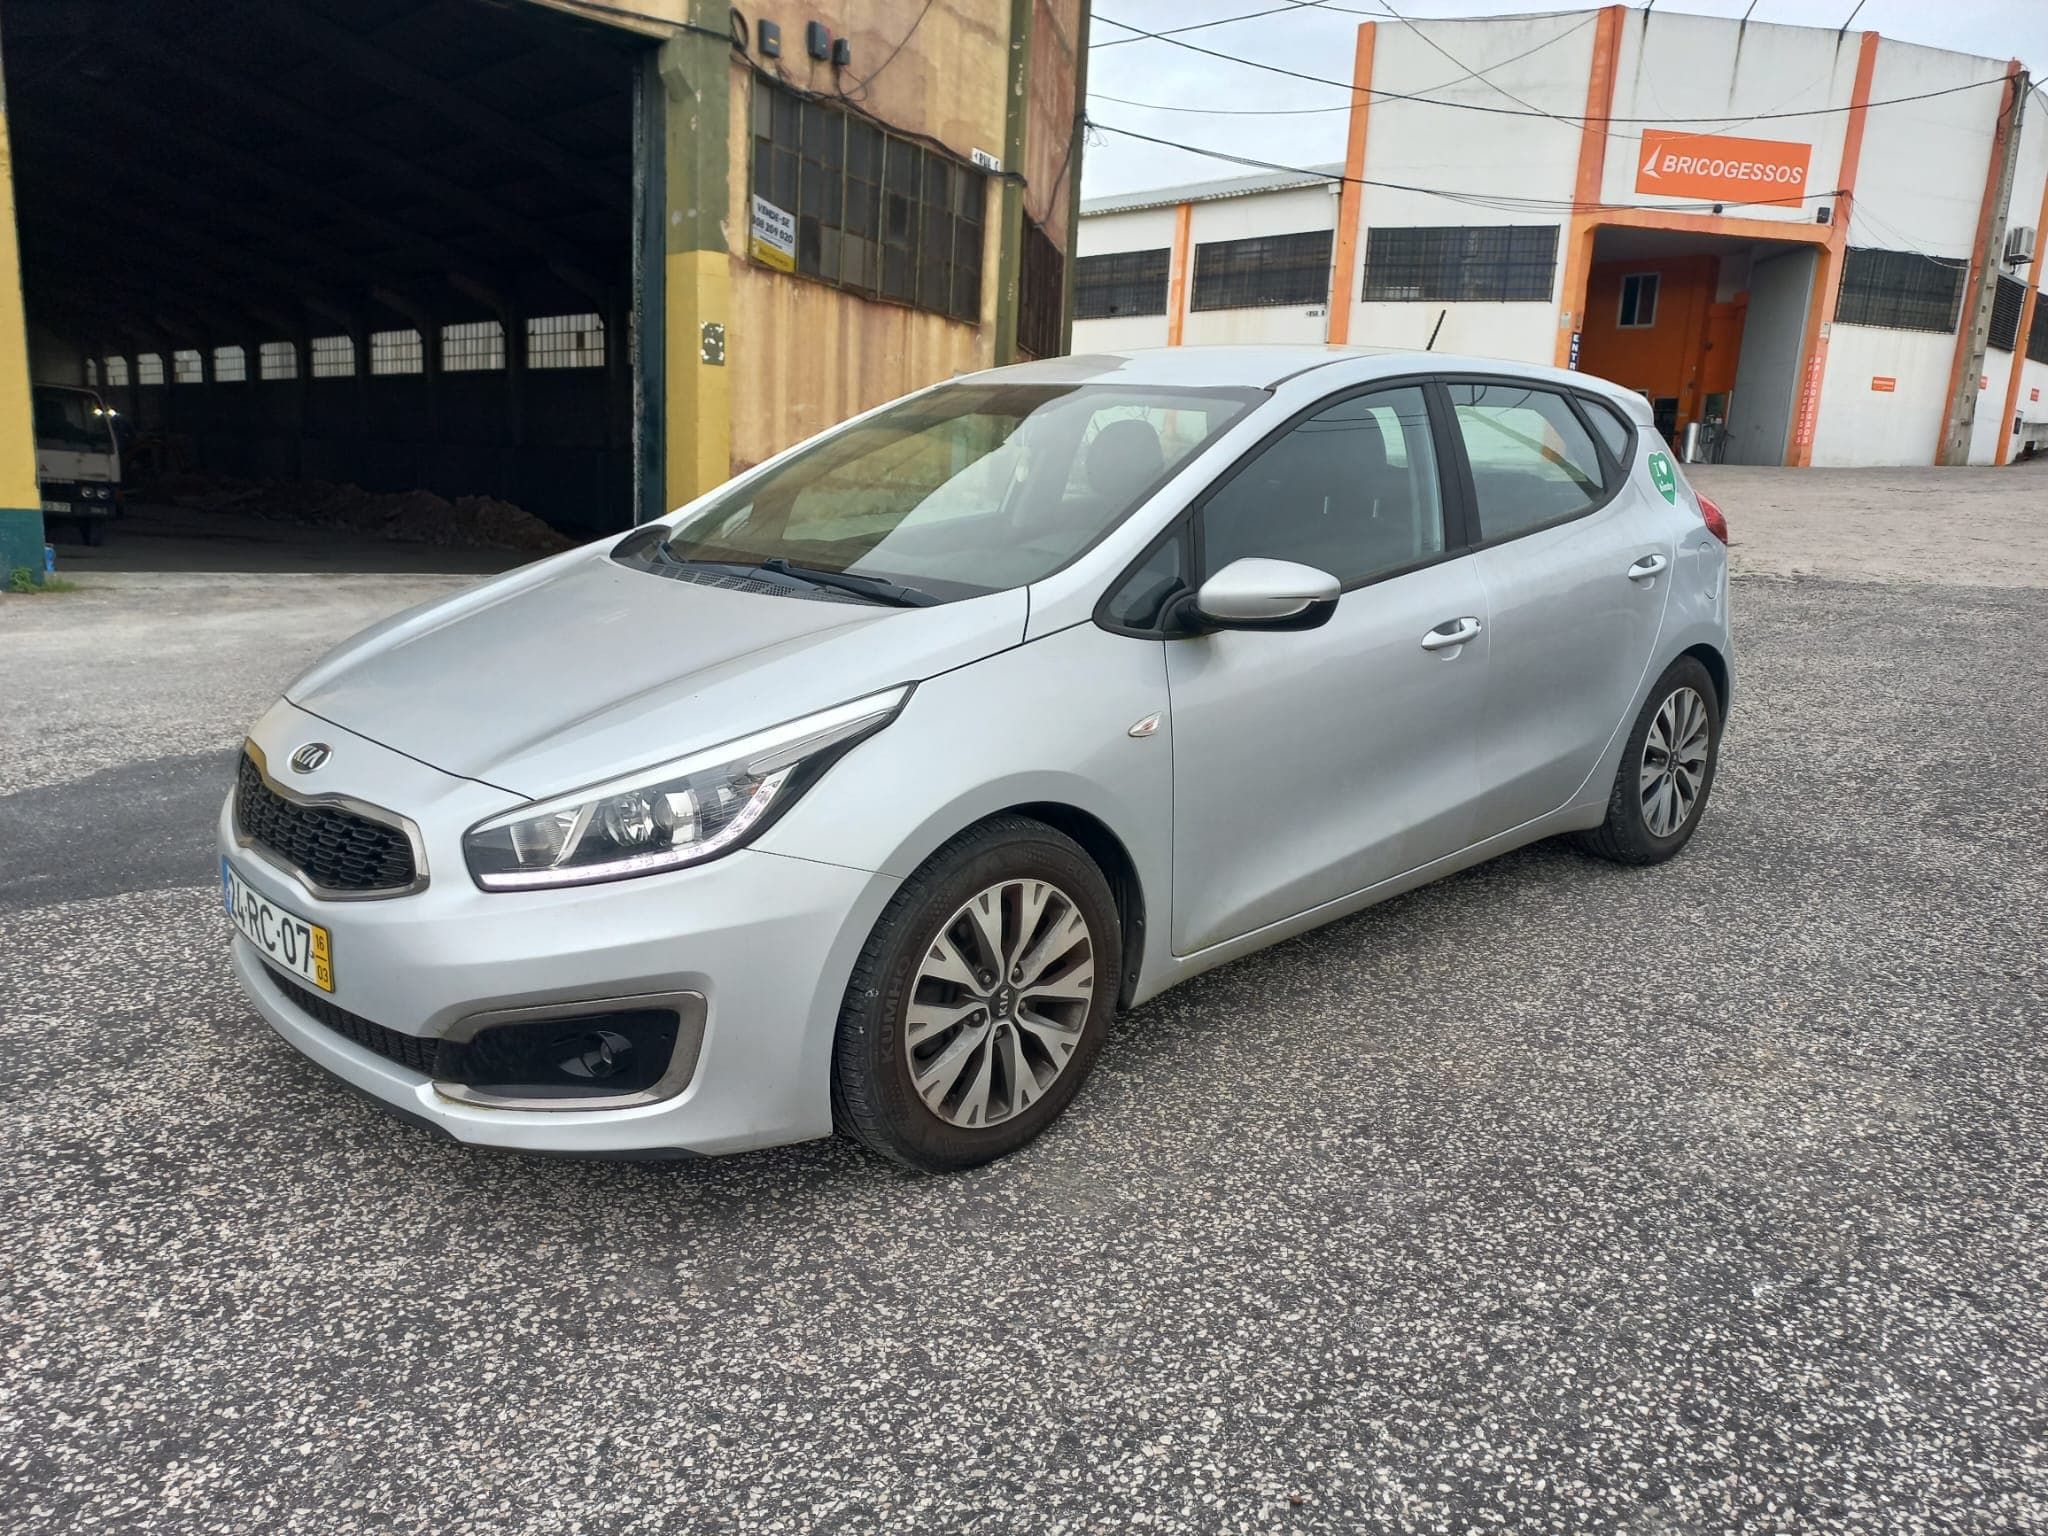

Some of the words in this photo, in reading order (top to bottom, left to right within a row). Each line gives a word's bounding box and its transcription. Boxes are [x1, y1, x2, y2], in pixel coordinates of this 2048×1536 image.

[1662, 155, 1803, 184] BRICOGESSOS
[757, 203, 790, 228] VENDE-SE
[295, 746, 324, 768] KIA
[229, 873, 311, 973] 24-RC-07
[316, 933, 325, 951] 16
[317, 964, 328, 983] 03
[881, 954, 912, 1060] KUMHO
[998, 989, 1008, 1017] KIA
